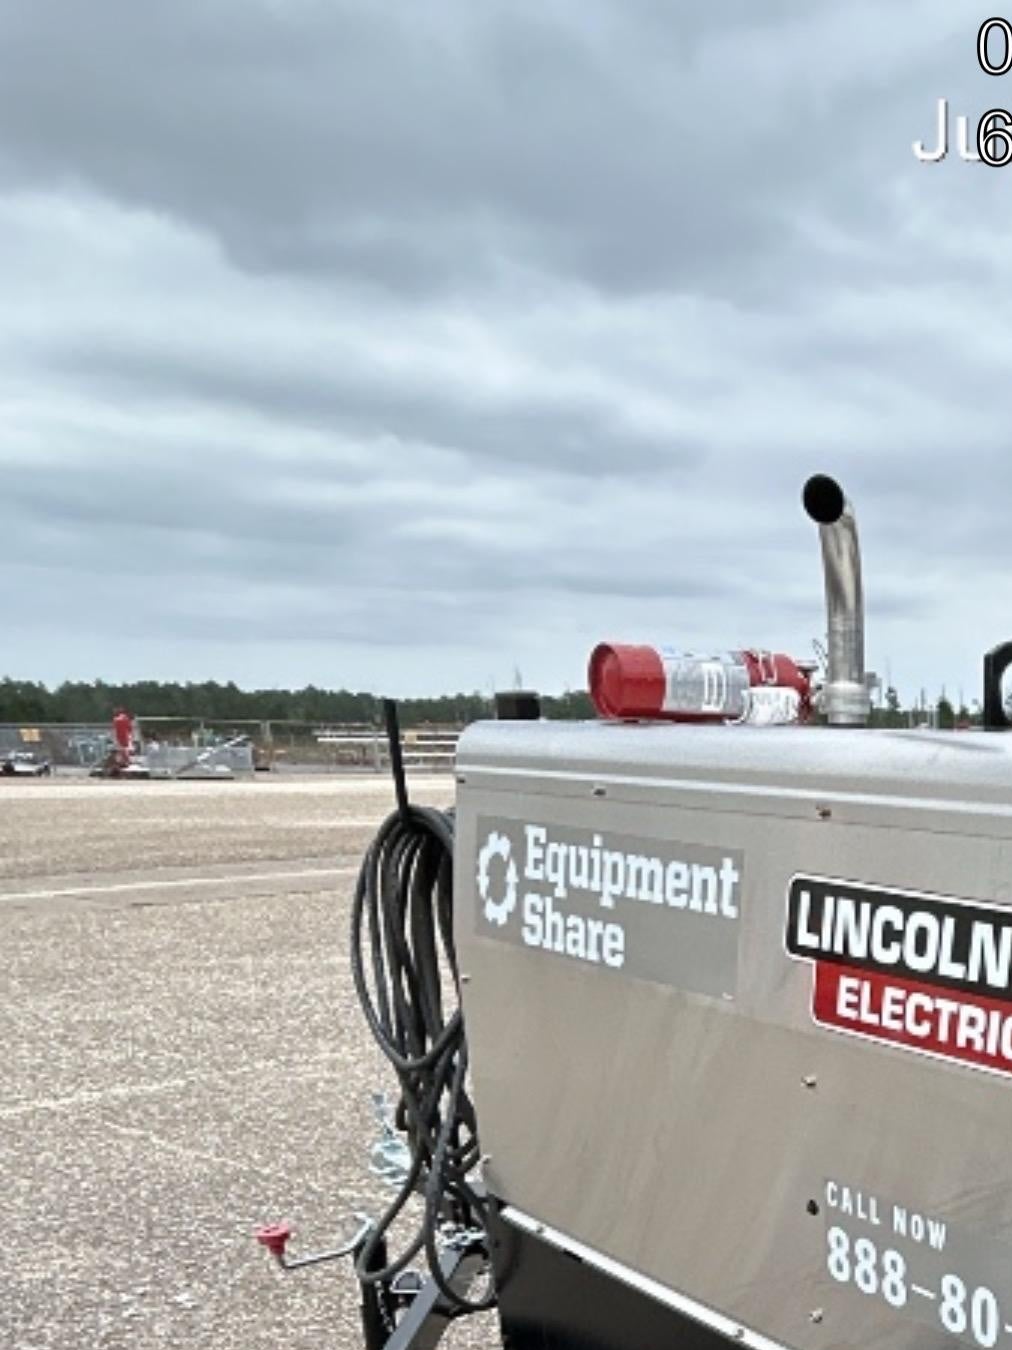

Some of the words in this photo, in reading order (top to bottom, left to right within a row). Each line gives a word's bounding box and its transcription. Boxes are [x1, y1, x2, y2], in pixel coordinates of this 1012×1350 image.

[524, 824, 740, 920] Equipment
[521, 893, 626, 968] Share
[826, 1181, 881, 1226] CALL
[892, 1205, 947, 1252] NOW
